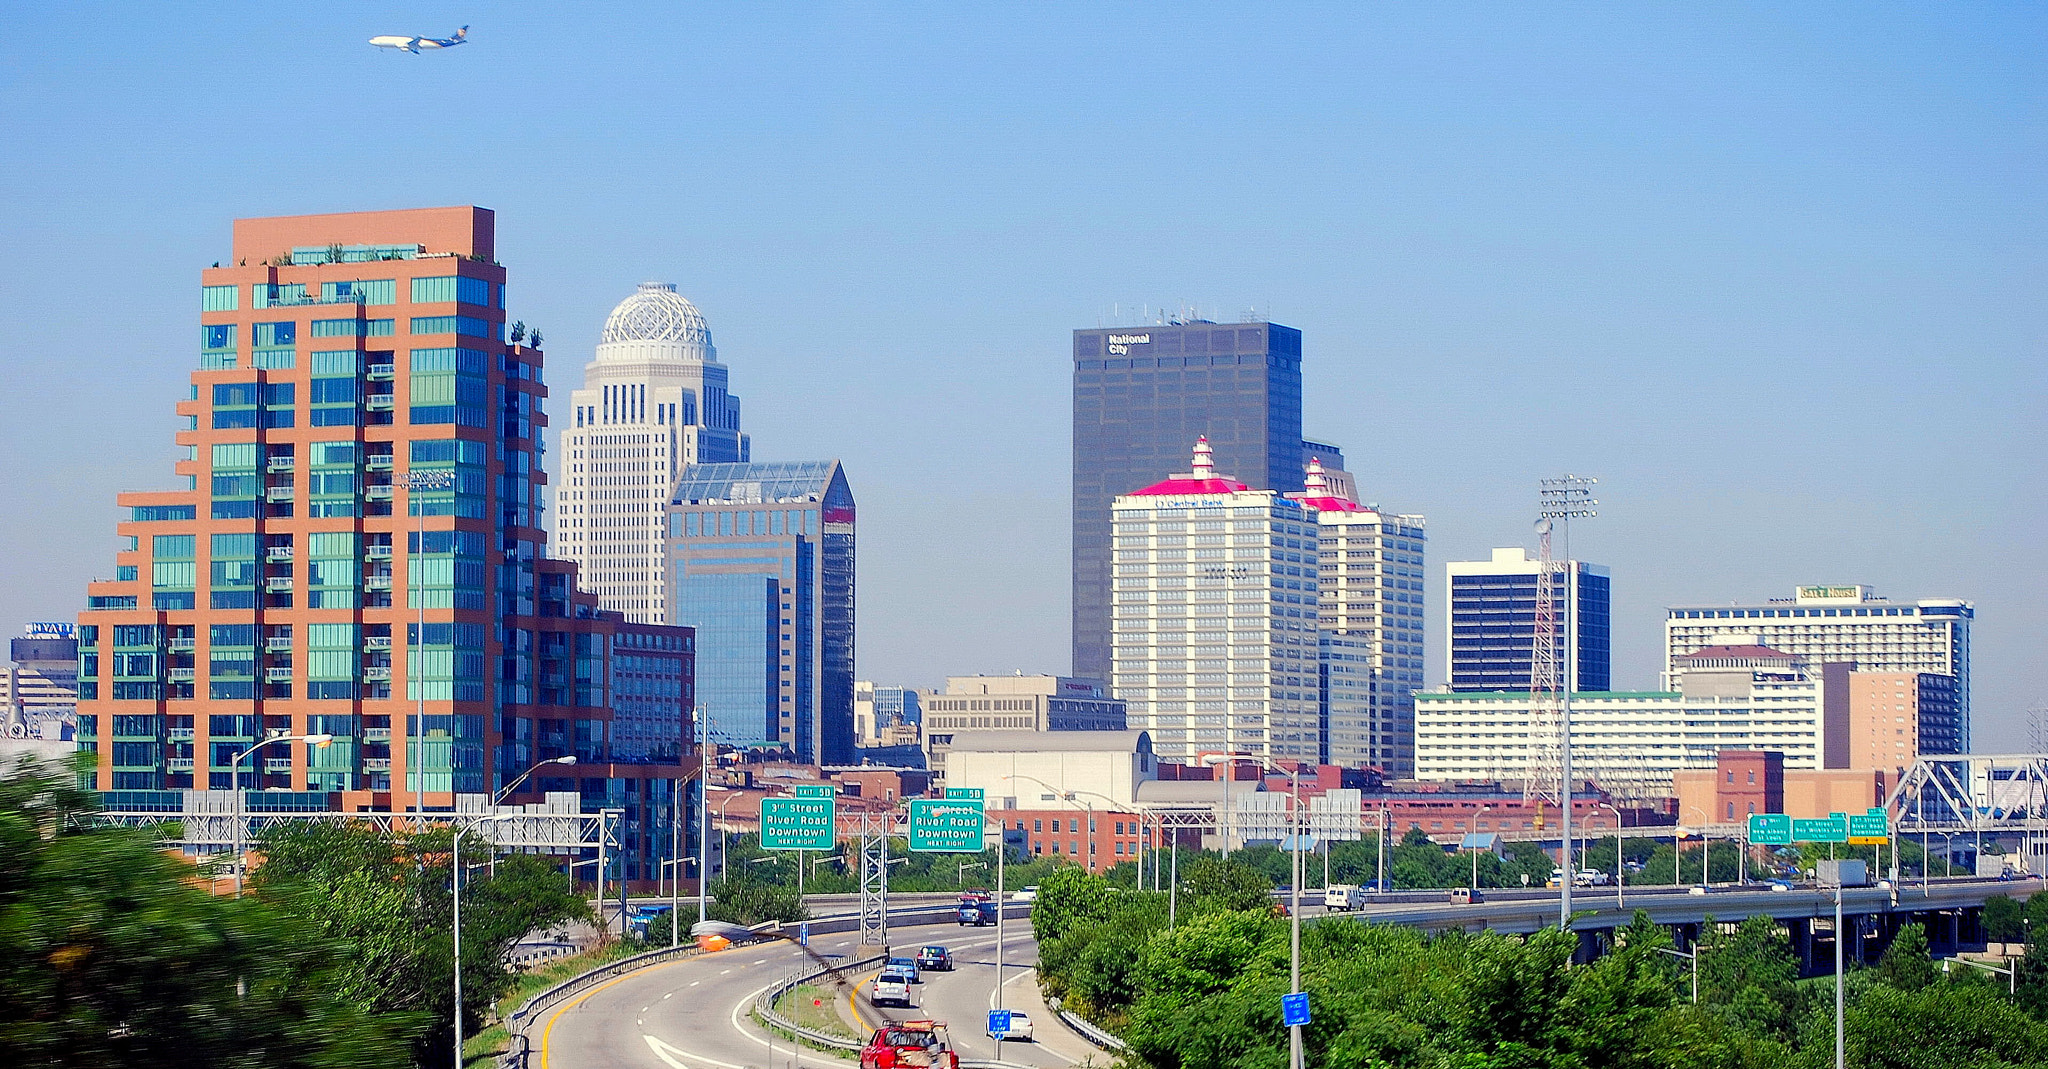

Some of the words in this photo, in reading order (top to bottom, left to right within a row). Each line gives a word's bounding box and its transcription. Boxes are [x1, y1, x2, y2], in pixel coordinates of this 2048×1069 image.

[1108, 333, 1150, 345] National
[1108, 344, 1128, 356] City
[1201, 499, 1223, 508] Bank
[33, 622, 72, 634] HYATT
[789, 803, 824, 814] Street
[767, 815, 795, 825] River
[800, 815, 828, 825] Road
[916, 817, 945, 827] River
[950, 817, 978, 827] Road
[768, 827, 826, 837] Downtown
[917, 829, 975, 839] Downtown
